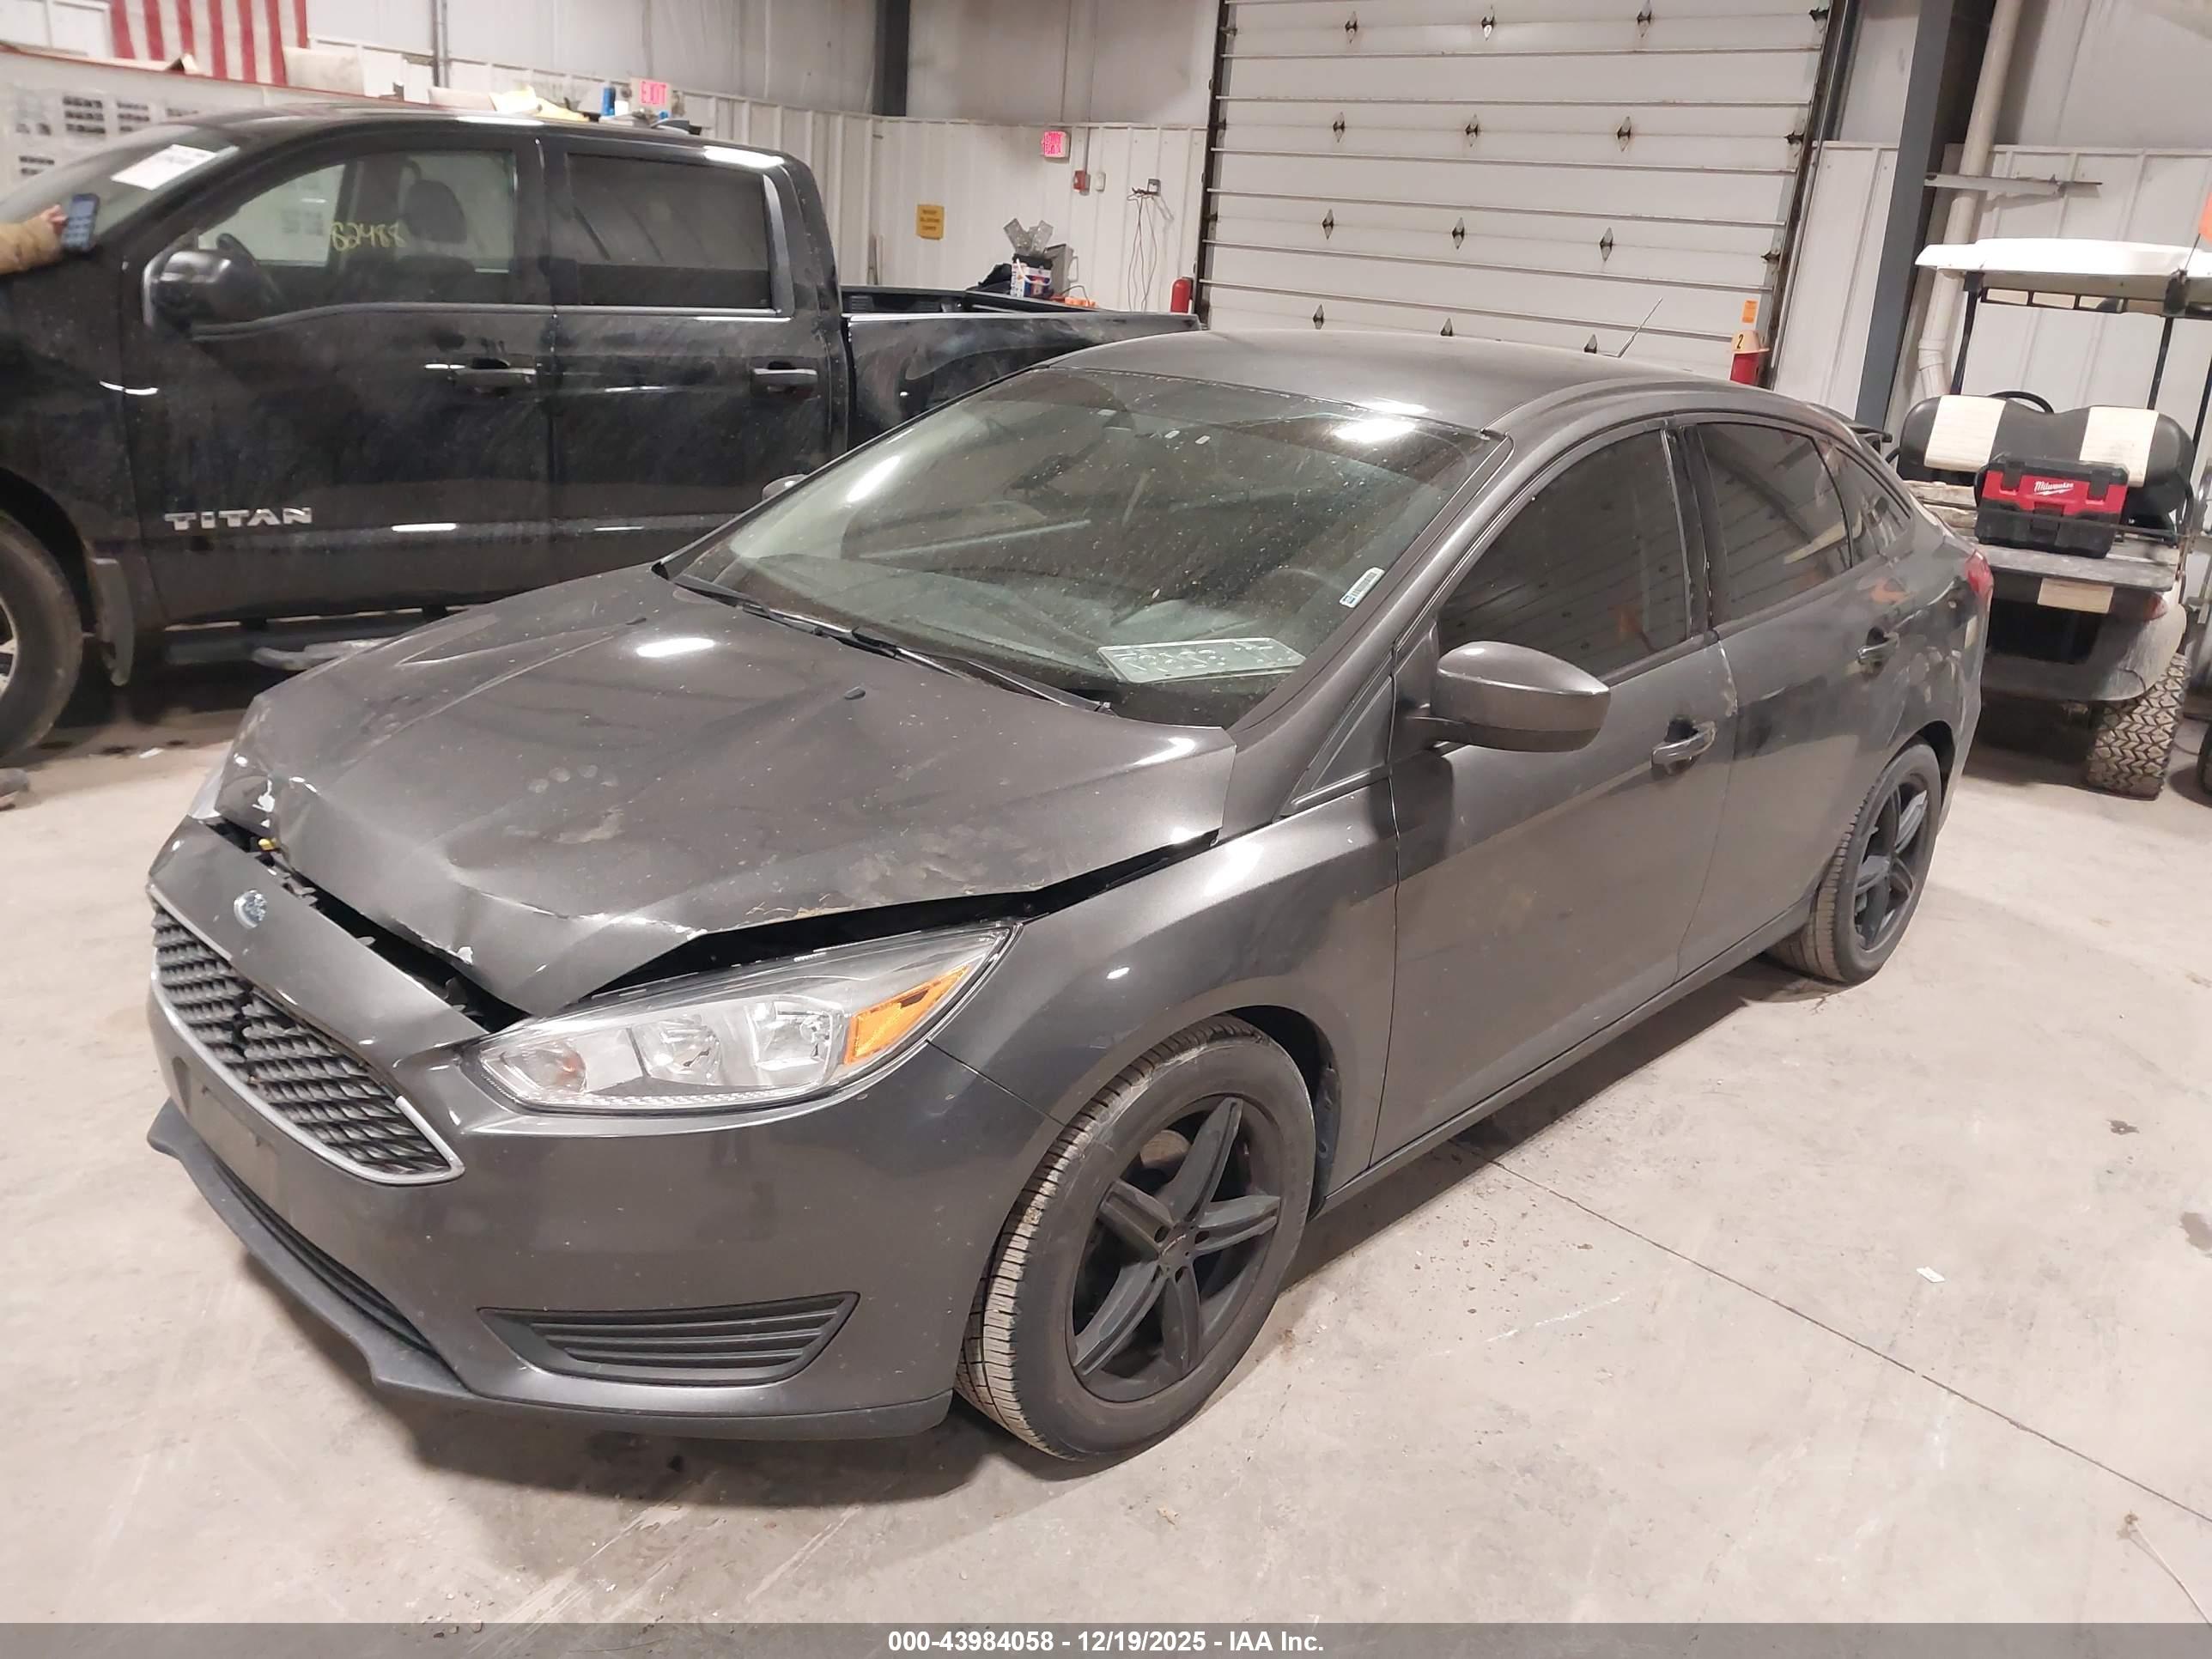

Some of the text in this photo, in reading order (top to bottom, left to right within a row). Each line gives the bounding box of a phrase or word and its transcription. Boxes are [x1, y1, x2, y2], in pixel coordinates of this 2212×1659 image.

[1736, 333, 1744, 349] 2
[2033, 480, 2075, 493] Milwaukee
[164, 507, 313, 531] TITAN
